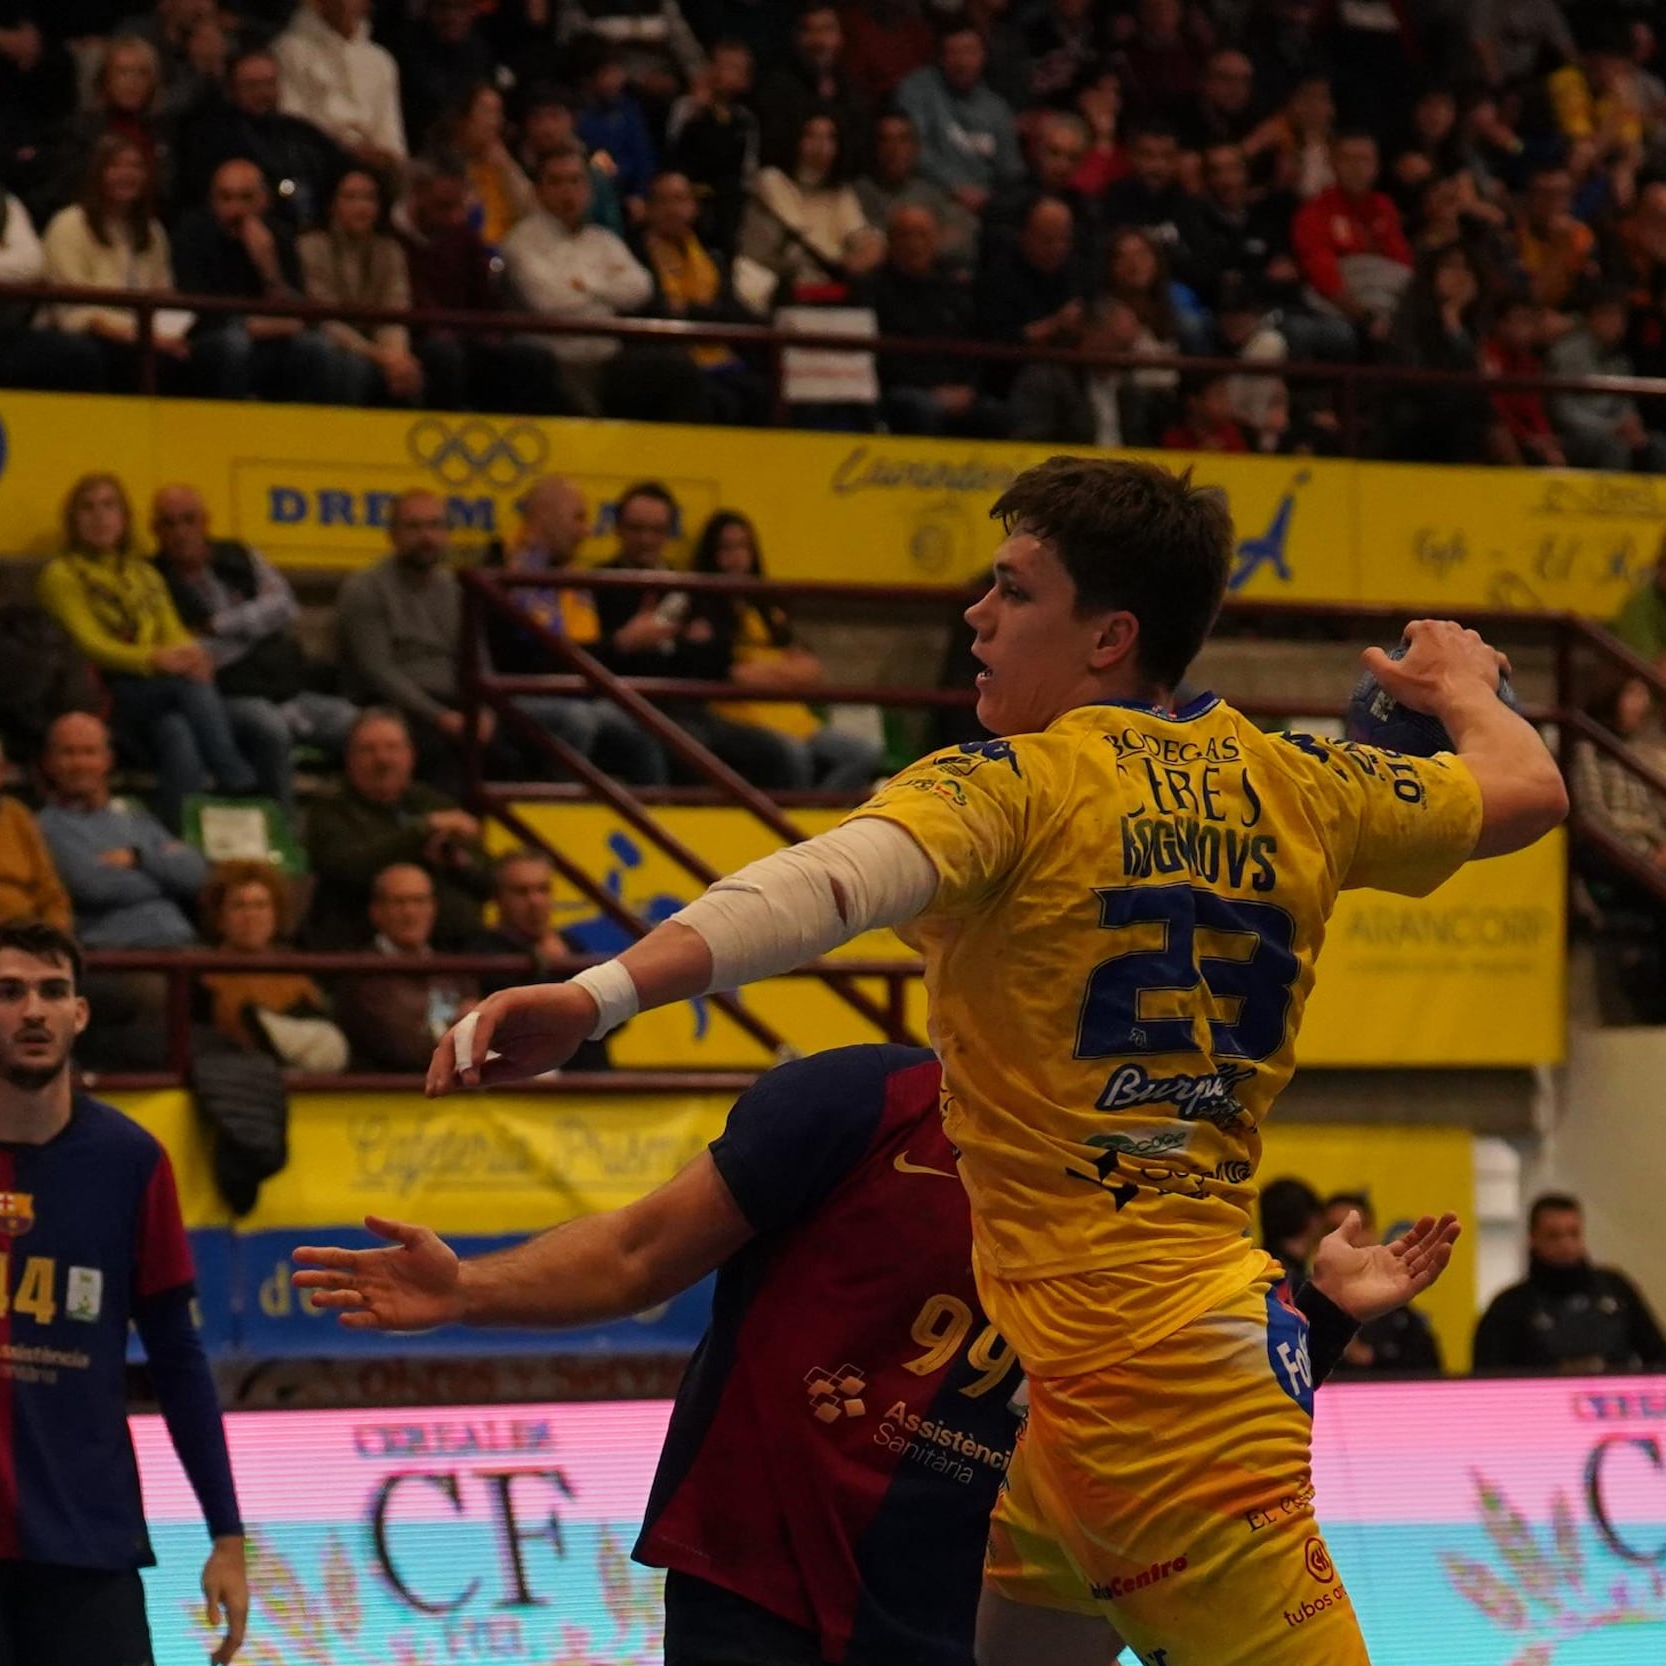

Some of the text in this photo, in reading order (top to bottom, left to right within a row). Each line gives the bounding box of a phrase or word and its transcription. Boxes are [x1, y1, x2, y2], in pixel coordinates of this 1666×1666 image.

[269, 486, 495, 533] DREM
[1103, 728, 1240, 763] BODEGAS
[1073, 878, 1301, 1063] 23
[900, 1293, 1018, 1400] 99
[873, 1421, 974, 1486] Sanitària
[884, 1400, 1013, 1471] Assistènci
[366, 1467, 577, 1613] CF
[1284, 1591, 1334, 1628] tubos
